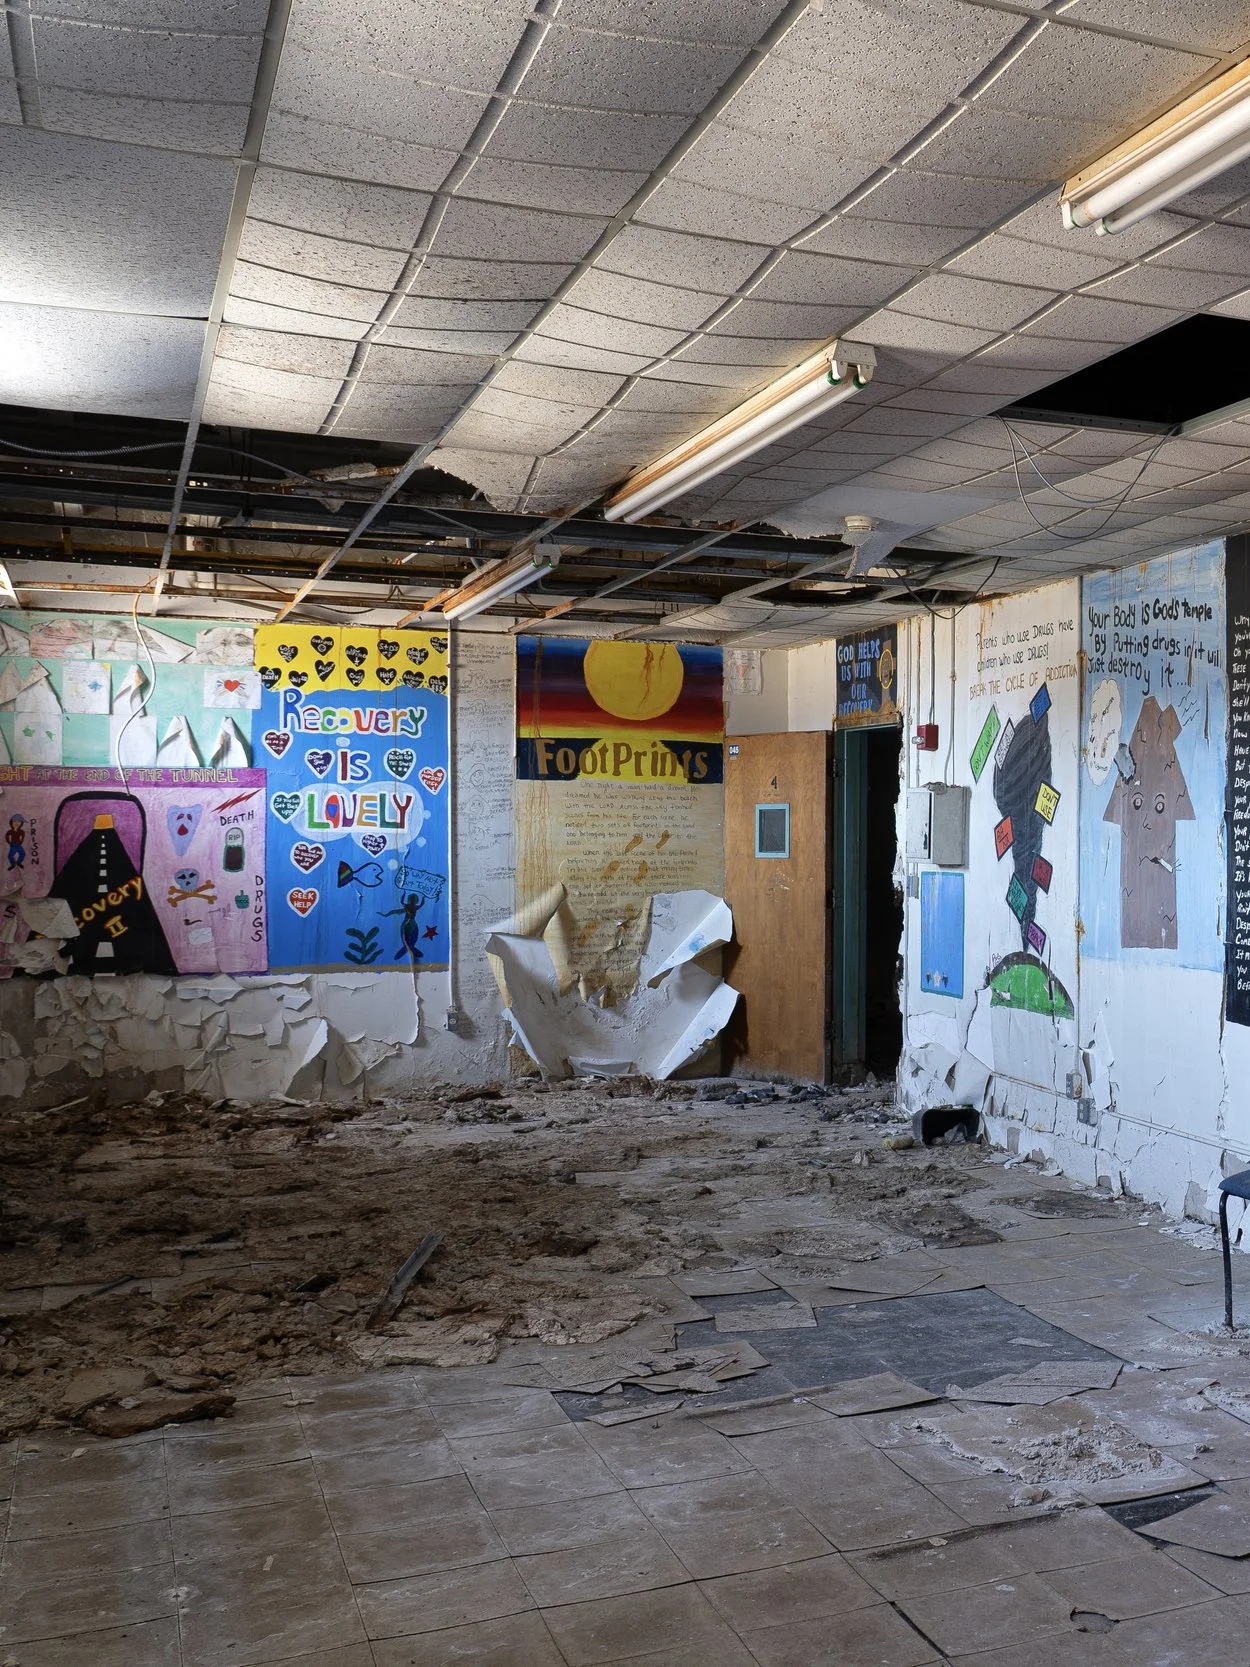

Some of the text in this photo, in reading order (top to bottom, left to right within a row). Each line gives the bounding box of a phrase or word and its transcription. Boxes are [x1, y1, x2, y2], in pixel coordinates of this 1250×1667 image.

[1114, 603, 1135, 629] Body
[1142, 601, 1150, 625] is
[1002, 631, 1015, 646] who
[1033, 623, 1053, 639] DRUGS
[1059, 620, 1074, 632] have
[1152, 629, 1180, 656] drugs
[1193, 641, 1205, 659] it
[838, 639, 880, 663] GOD HELPS
[999, 654, 1010, 666] who
[1028, 641, 1049, 661] DRUGS!
[842, 662, 871, 681] US WITH
[1108, 652, 1150, 695] destroy
[852, 684, 867, 699] OUR
[969, 684, 987, 700] BREAK
[988, 680, 1001, 696] THE
[1006, 673, 1024, 692] CYCLE
[1029, 672, 1038, 687] OF
[280, 688, 427, 738] Recovery
[57, 769, 78, 780] THE
[137, 769, 164, 782] THE
[170, 769, 238, 783] TUNNEL
[771, 776, 777, 789] 4
[219, 810, 255, 827] DEATH
[306, 791, 413, 830] LOVELY
[30, 819, 40, 865] PRISON
[228, 833, 240, 841] RIP
[251, 875, 264, 942] DRUGS
[292, 892, 314, 900] SEEK
